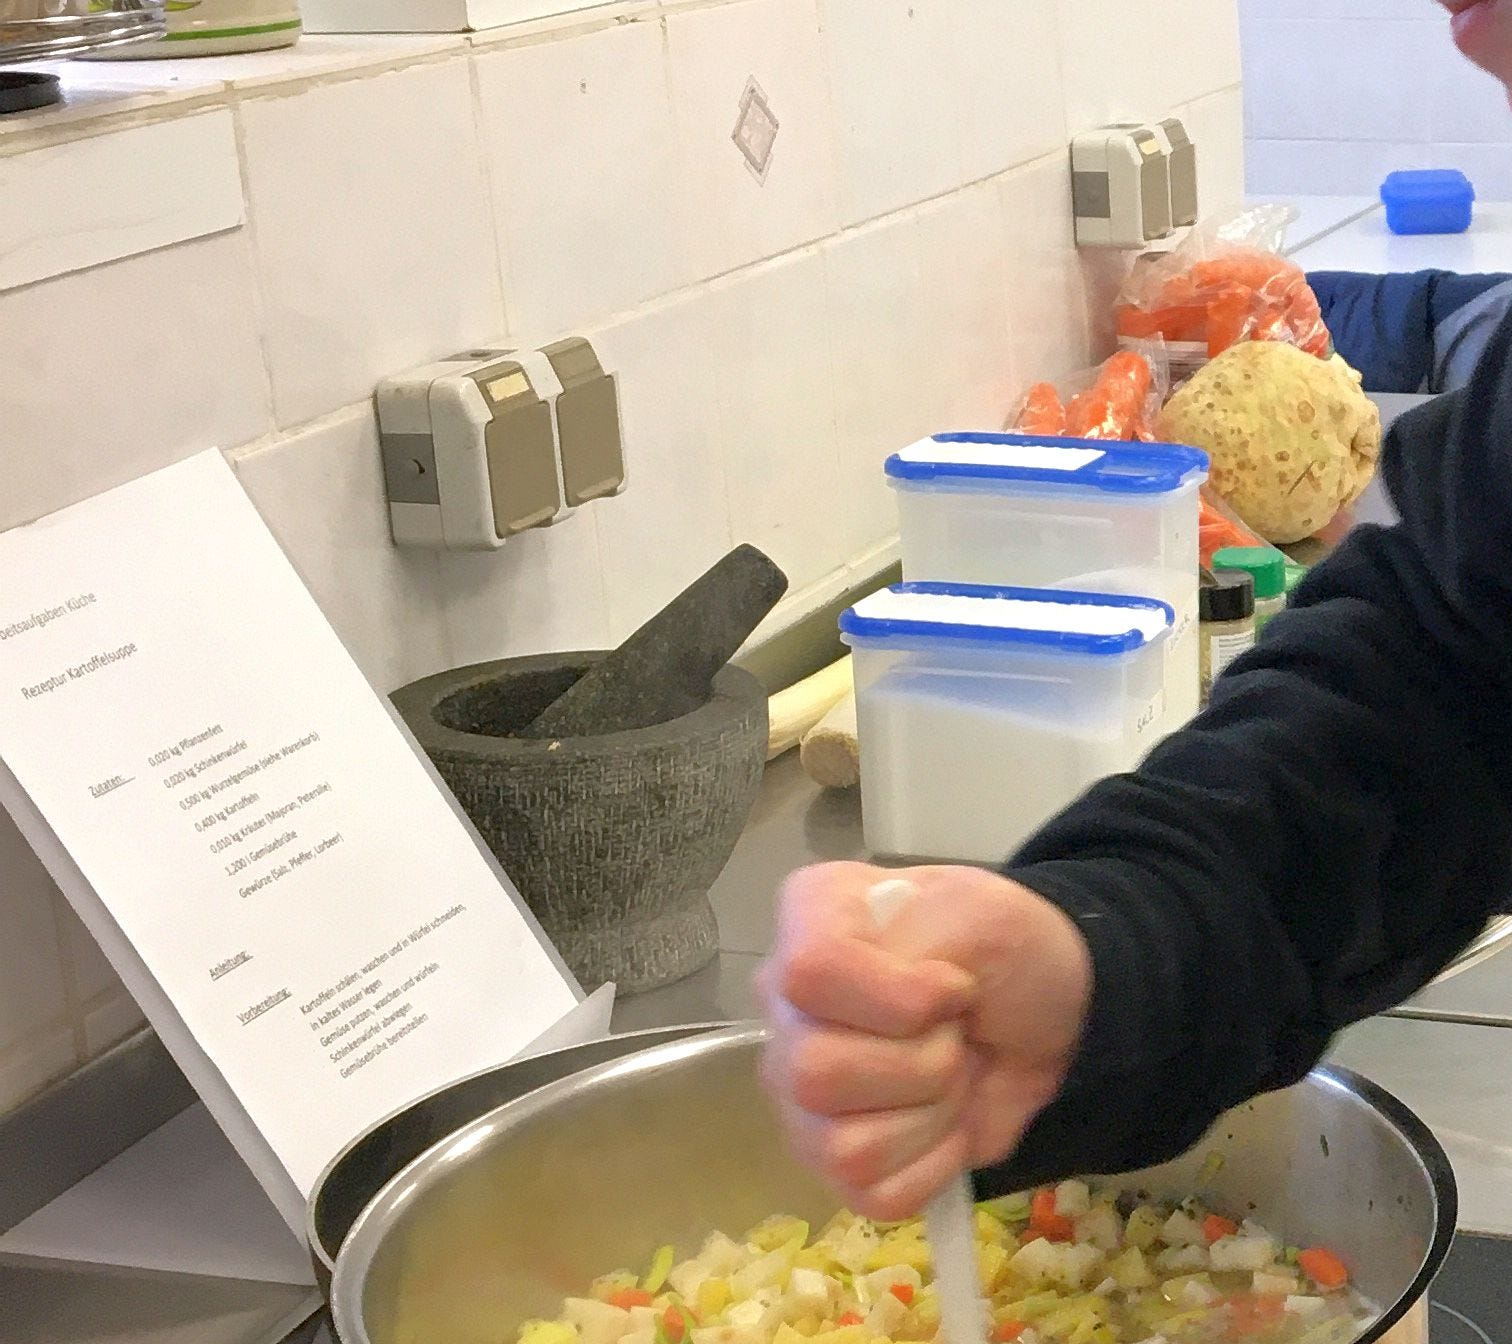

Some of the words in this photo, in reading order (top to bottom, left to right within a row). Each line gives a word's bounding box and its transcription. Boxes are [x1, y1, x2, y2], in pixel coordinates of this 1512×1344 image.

[65, 593, 97, 612] Küche
[20, 673, 68, 700] Rezeptur
[66, 642, 138, 681] Kartoffelsuppe
[239, 875, 273, 898] Gewürze
[299, 987, 336, 1015] Kartoffeln
[320, 1023, 351, 1047] Gemüse
